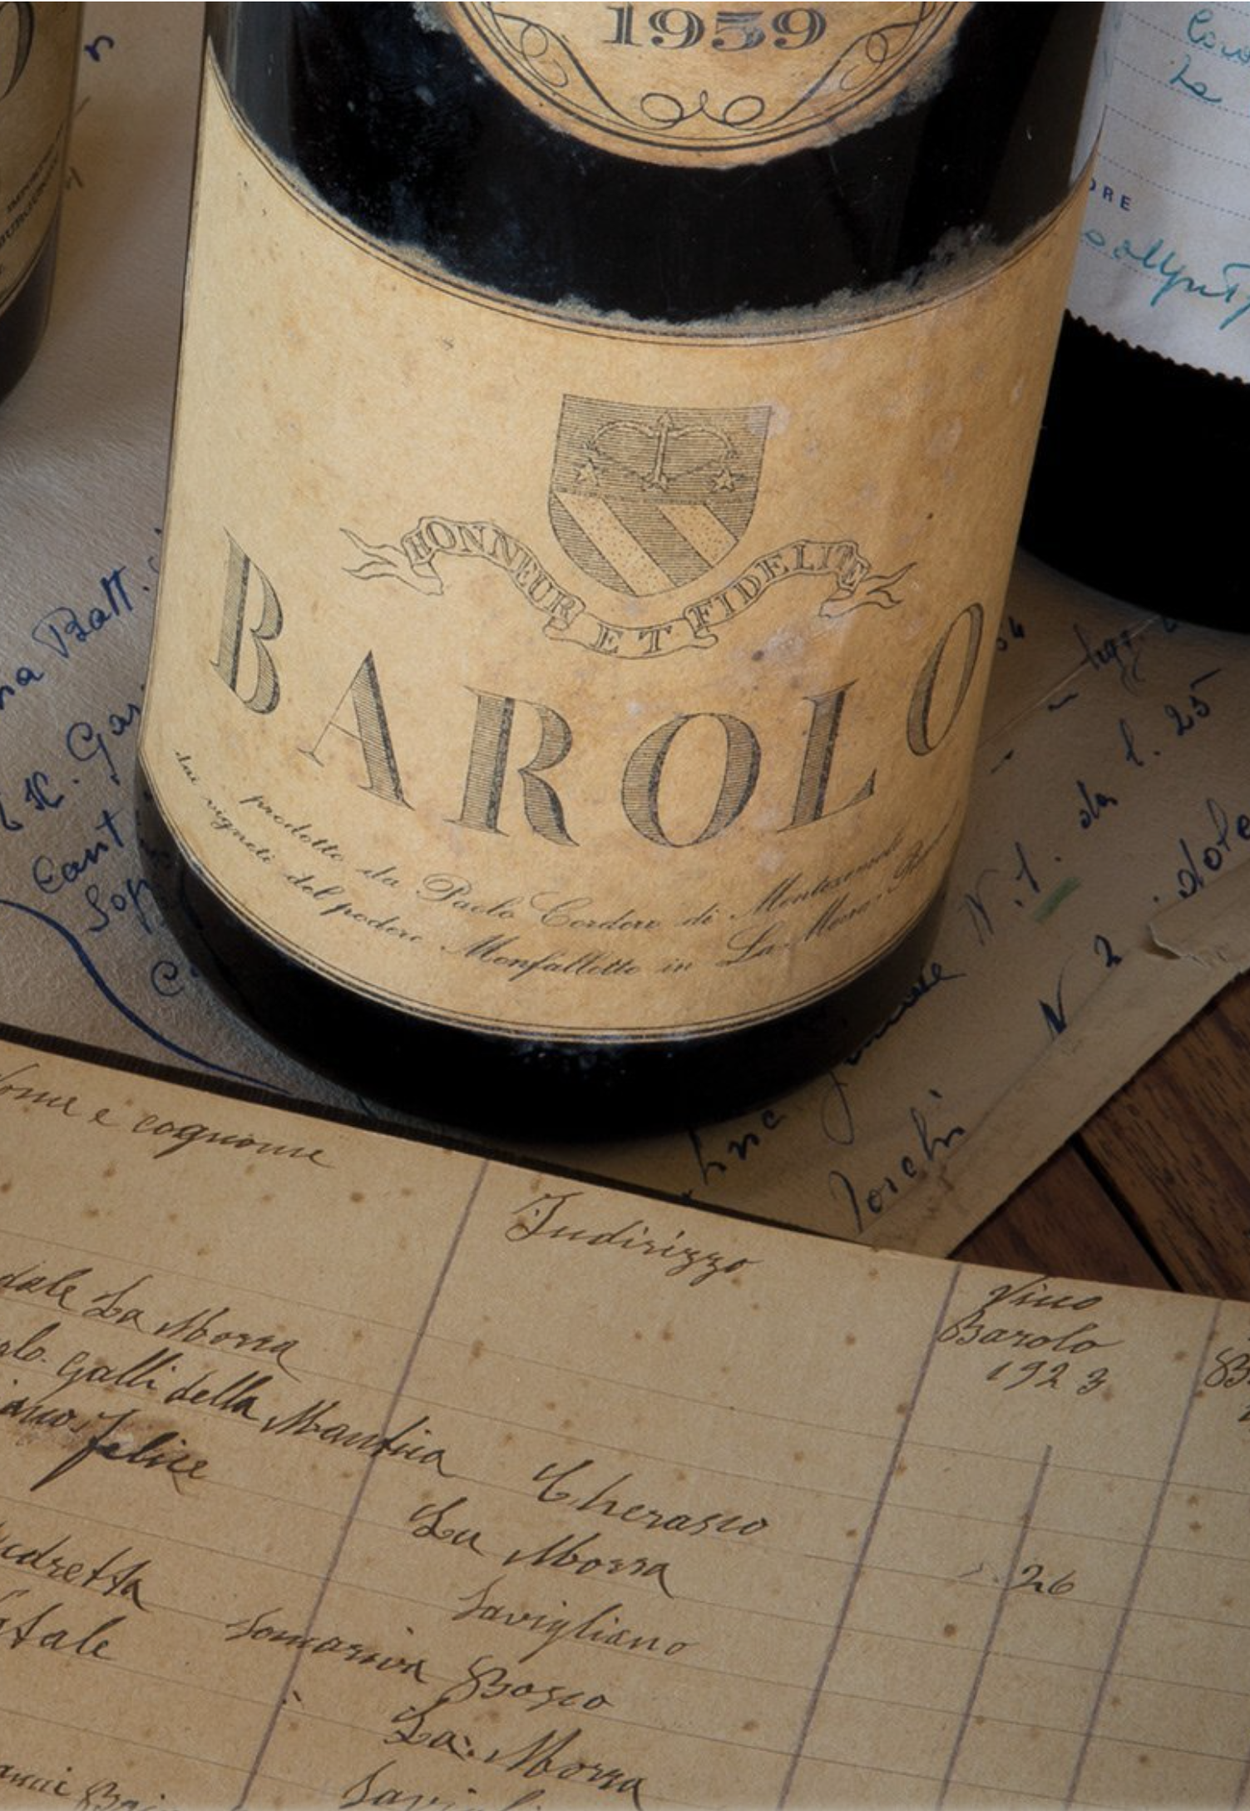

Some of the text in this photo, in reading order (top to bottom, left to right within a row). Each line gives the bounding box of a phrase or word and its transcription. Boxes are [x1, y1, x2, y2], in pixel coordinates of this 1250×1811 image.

[603, 4, 827, 52] 1959
[405, 520, 578, 621] HONNEUR
[591, 622, 674, 656] ET
[210, 528, 983, 848] BAROLO
[175, 750, 200, 786] dai
[205, 797, 277, 865] vigneti
[284, 874, 345, 901] del
[319, 902, 423, 943] podere
[441, 933, 641, 982] Monfalletto
[239, 795, 344, 862] prodotto
[356, 866, 399, 887] da
[416, 873, 524, 919] Paolo
[530, 891, 661, 930] Cordero
[674, 902, 720, 926] di
[93, 1106, 118, 1128] e
[133, 1113, 336, 1170] cognome
[505, 1192, 763, 1287] Indirizzo
[937, 1309, 1124, 1354] Barolo
[986, 1361, 1108, 1395] 1923
